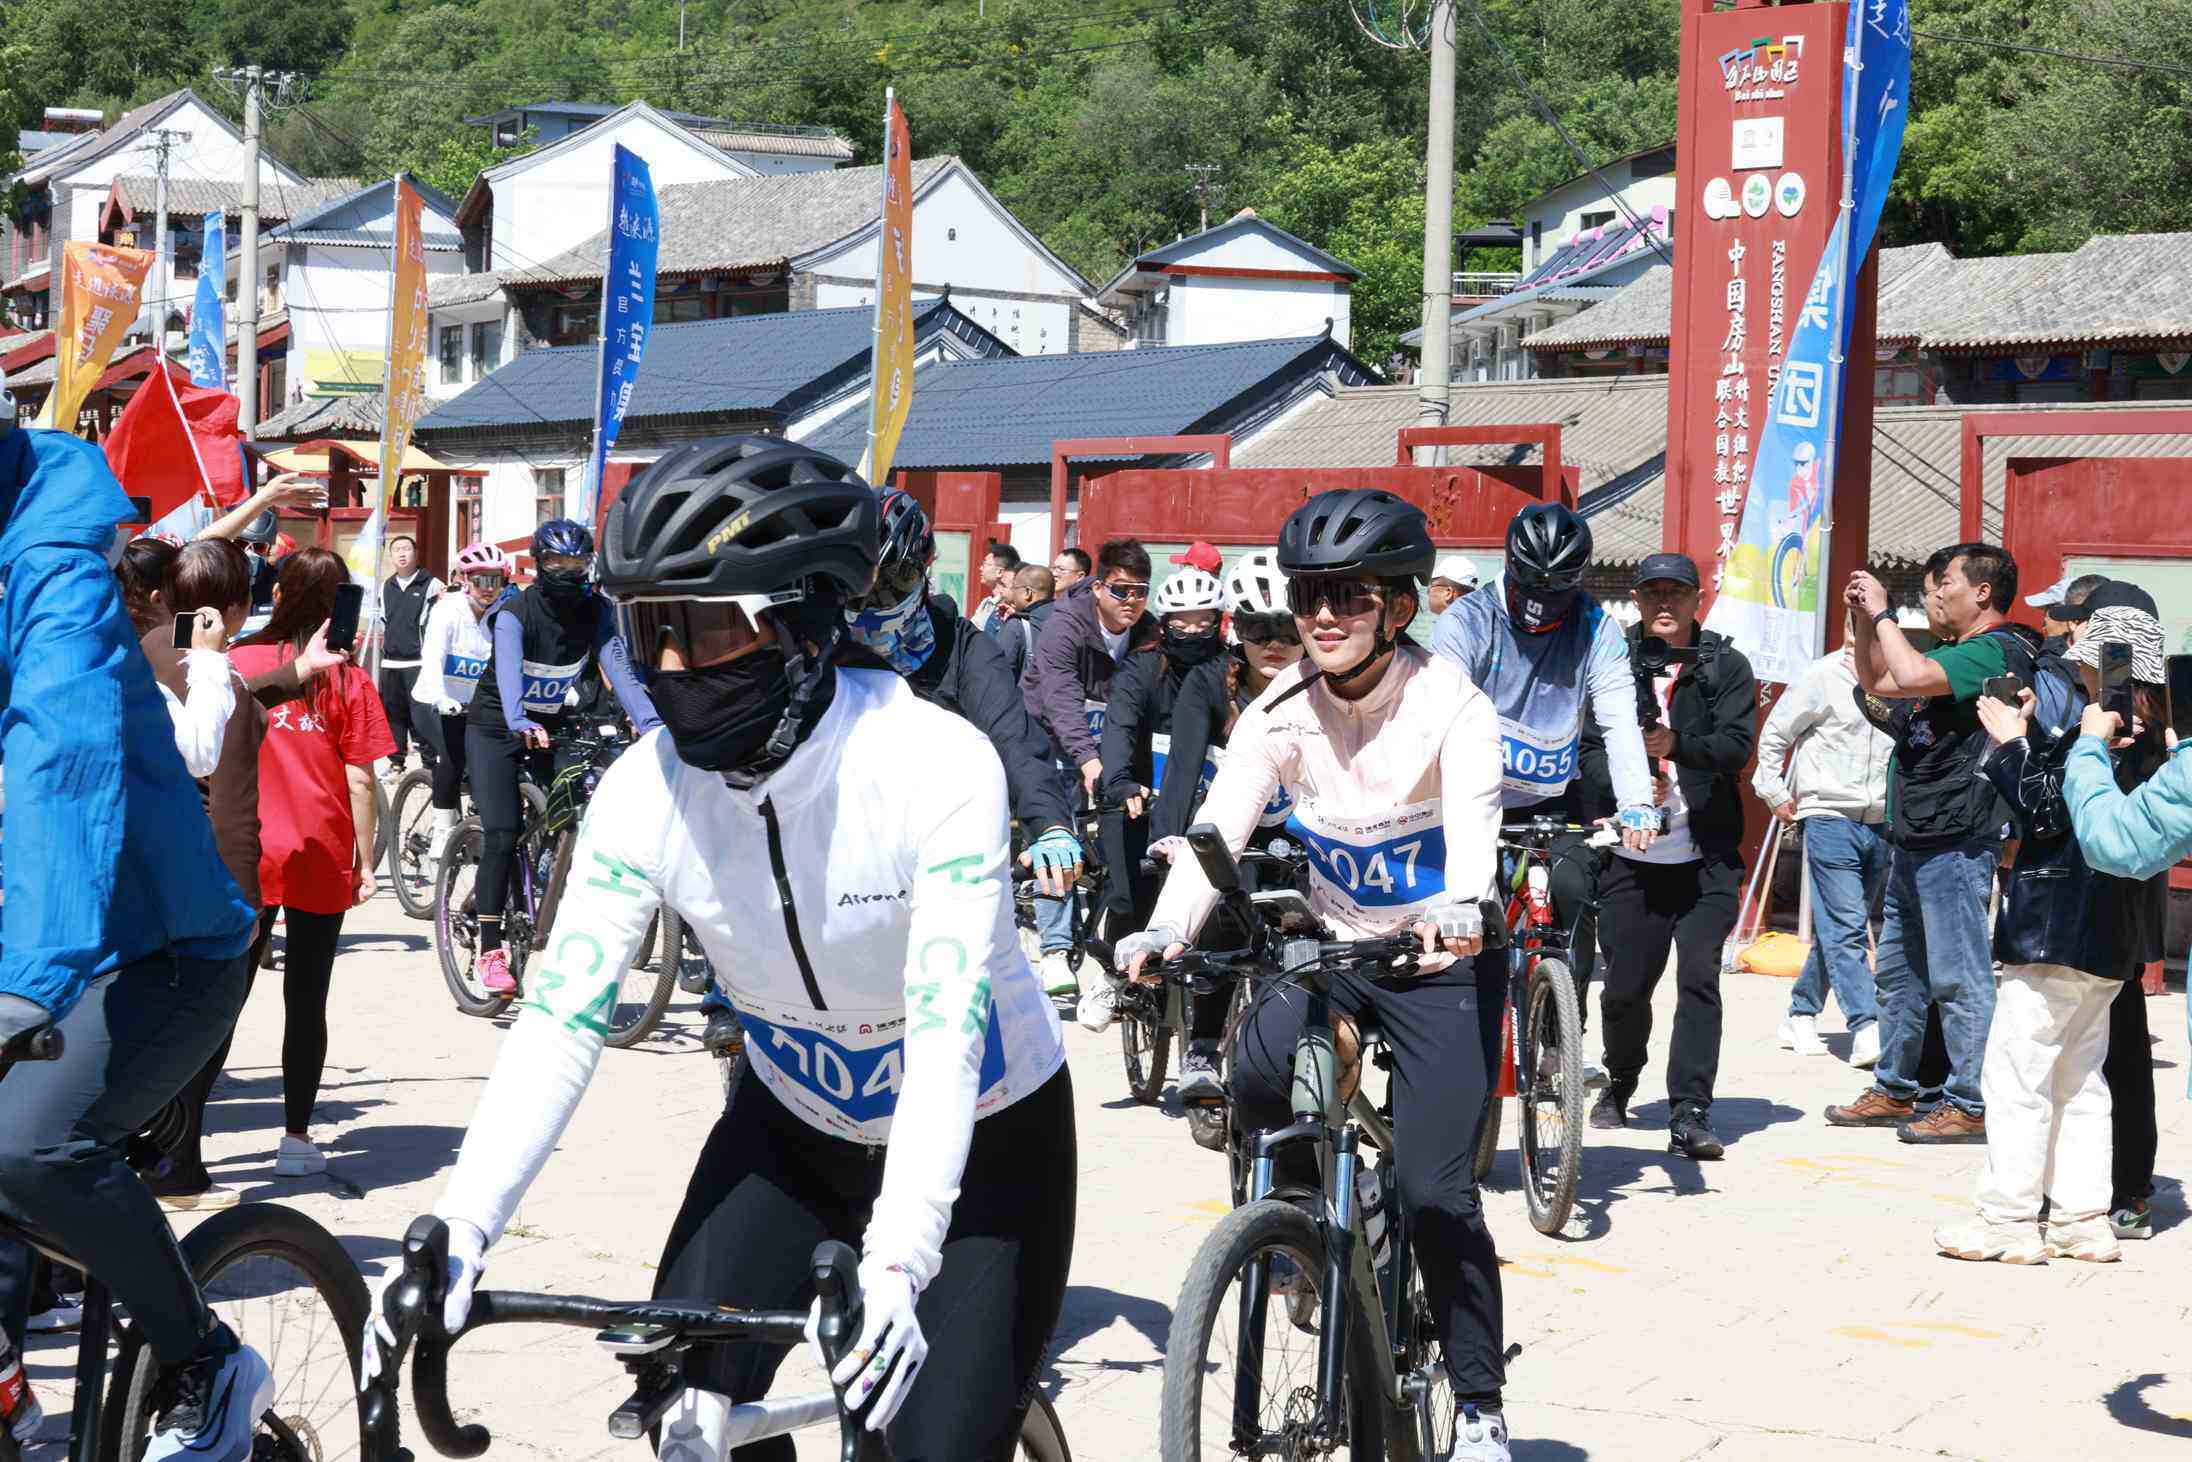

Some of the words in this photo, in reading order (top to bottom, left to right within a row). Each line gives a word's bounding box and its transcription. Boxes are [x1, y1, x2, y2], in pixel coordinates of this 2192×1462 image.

[1722, 238, 1746, 376] 中国房山
[1768, 240, 1785, 356] FANGSHAN
[707, 510, 751, 556] PMT
[454, 659, 488, 677] A0
[1502, 740, 1572, 779] A055
